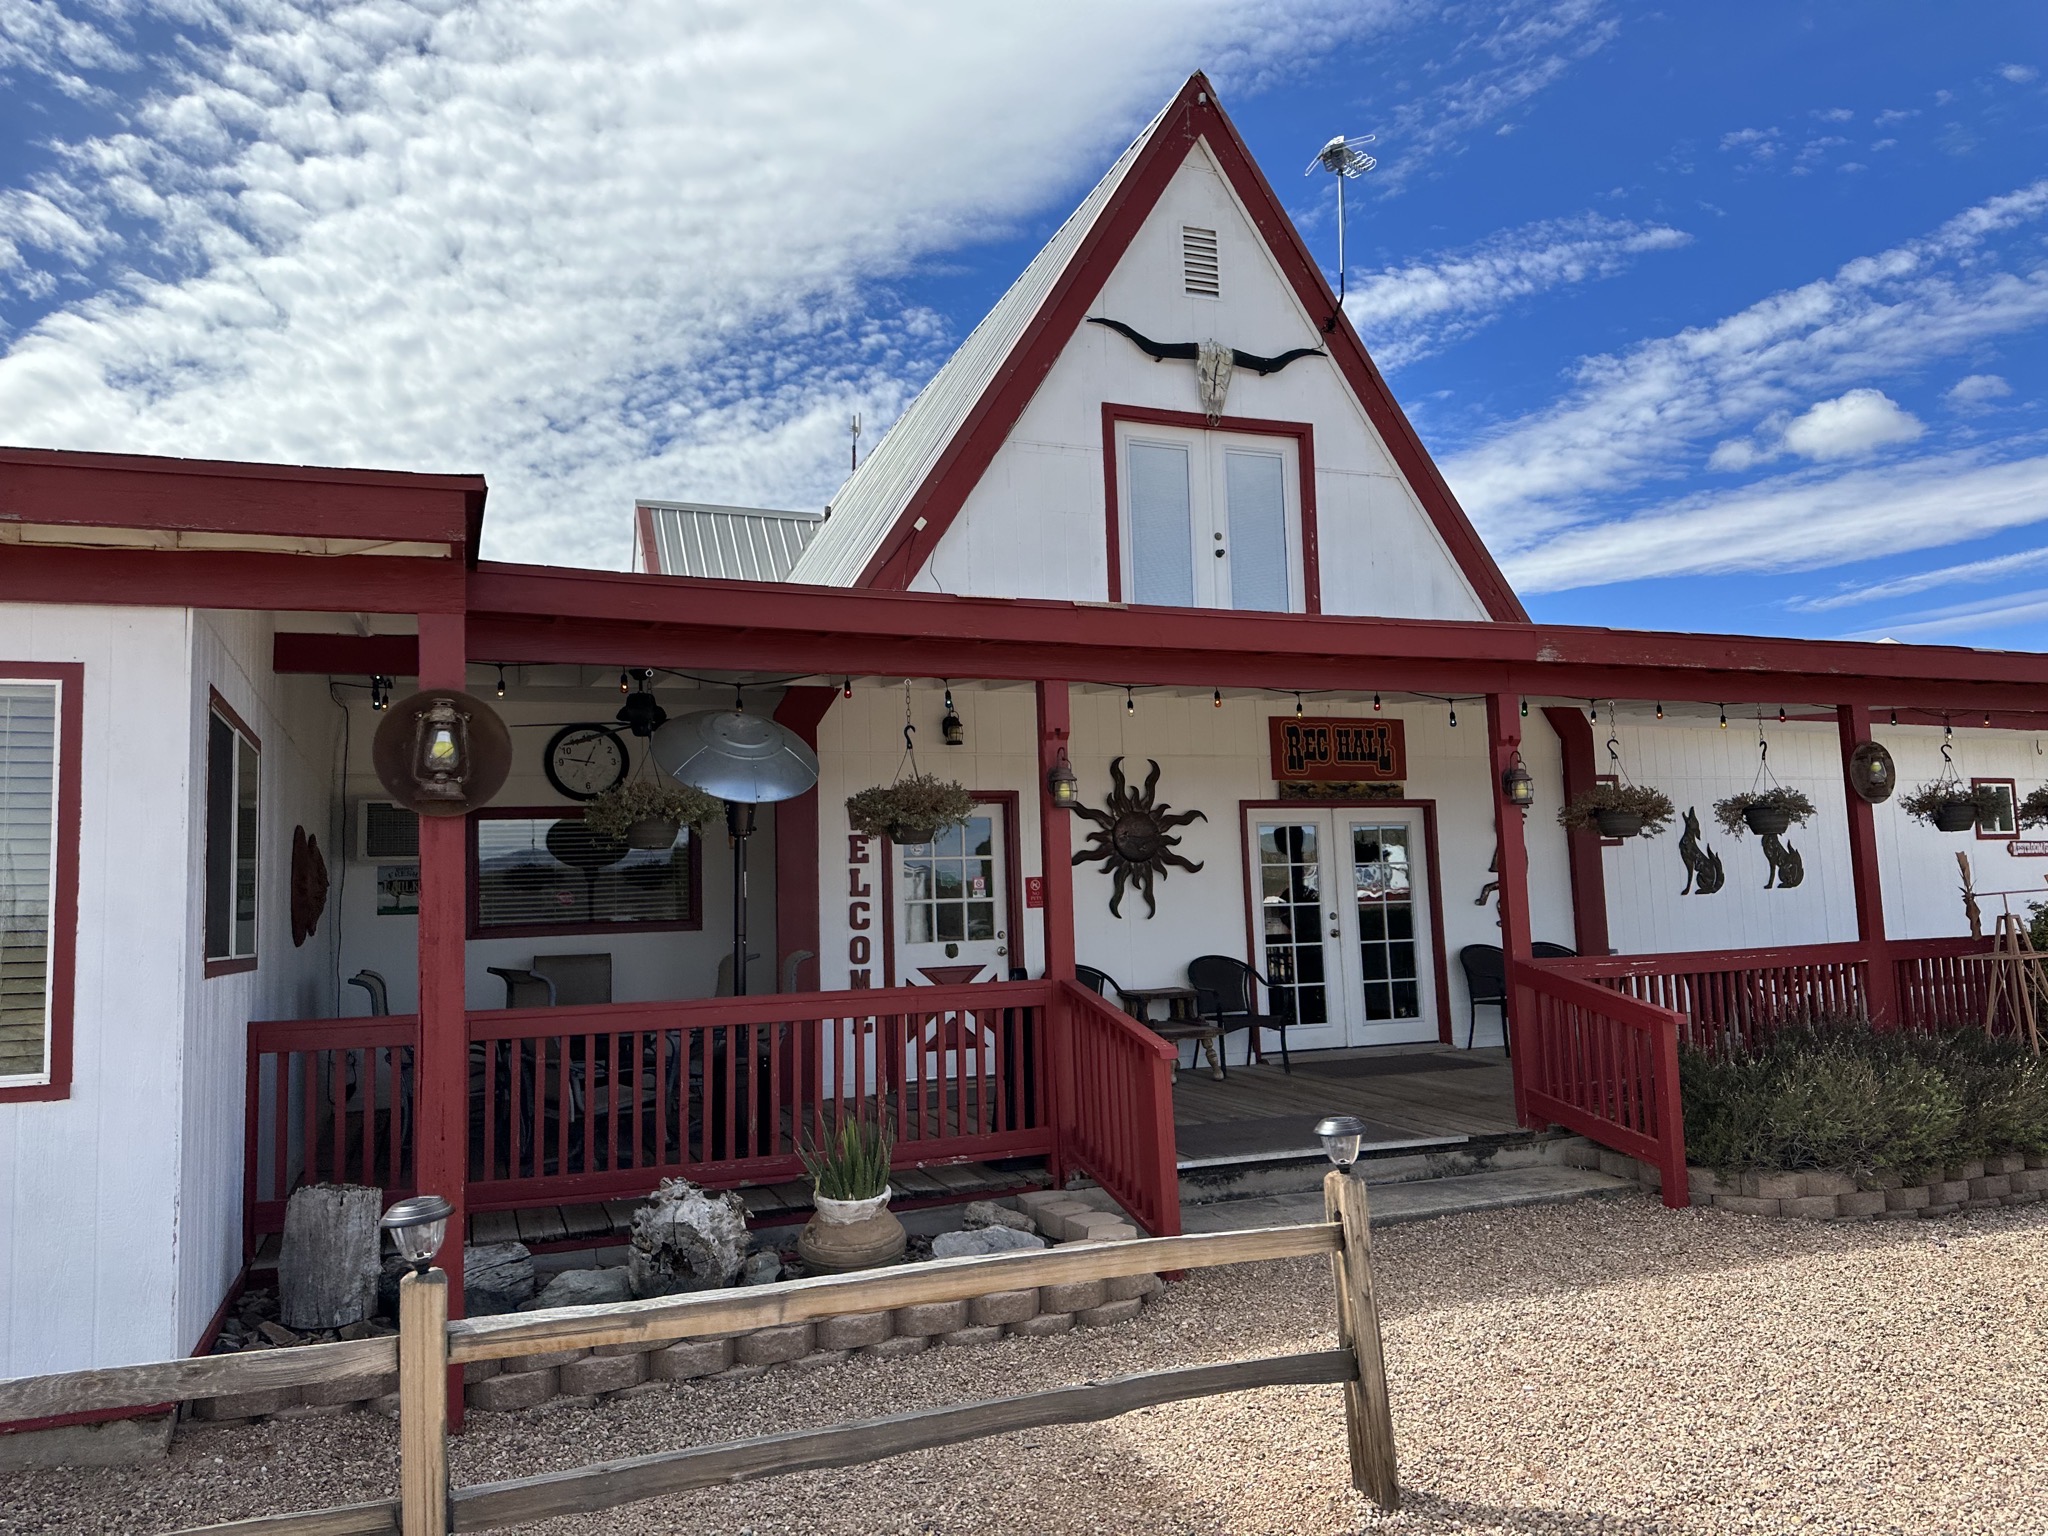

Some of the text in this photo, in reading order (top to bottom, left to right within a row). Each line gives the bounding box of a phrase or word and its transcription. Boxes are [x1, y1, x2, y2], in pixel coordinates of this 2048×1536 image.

[561, 746, 572, 755] 10
[606, 746, 613, 754] 2
[1286, 726, 1392, 771] REC HALL
